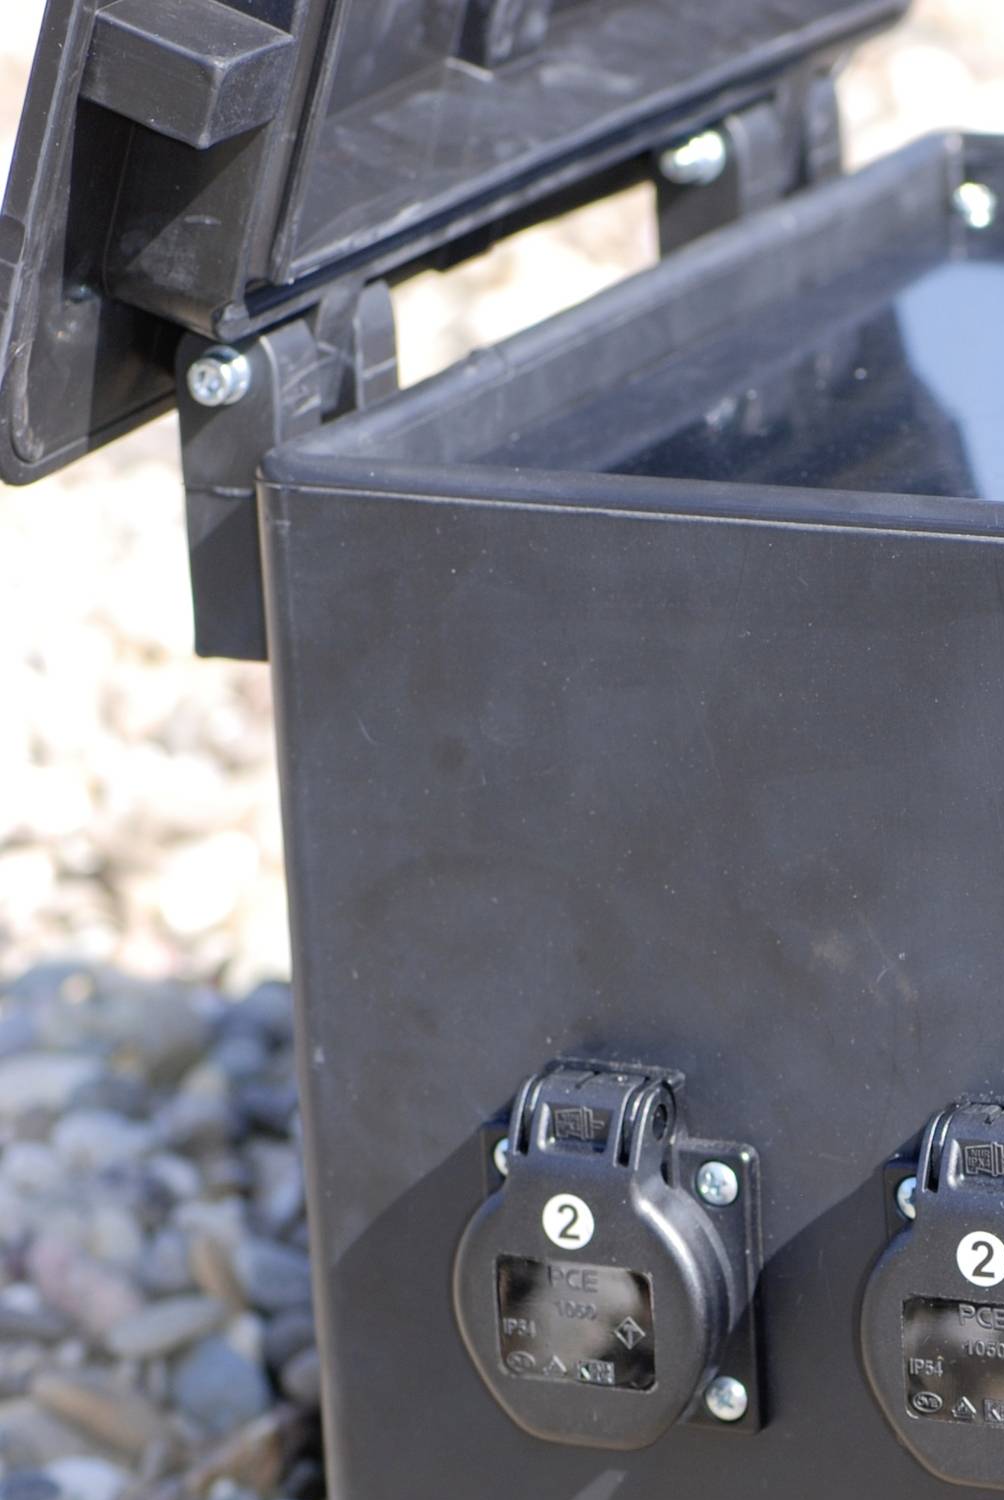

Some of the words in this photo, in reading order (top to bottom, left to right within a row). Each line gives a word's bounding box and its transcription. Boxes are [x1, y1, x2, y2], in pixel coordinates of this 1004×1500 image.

[557, 1203, 581, 1241] 2
[971, 1240, 996, 1278] 2
[548, 1264, 599, 1294] PCE
[909, 1357, 943, 1377] IP54
